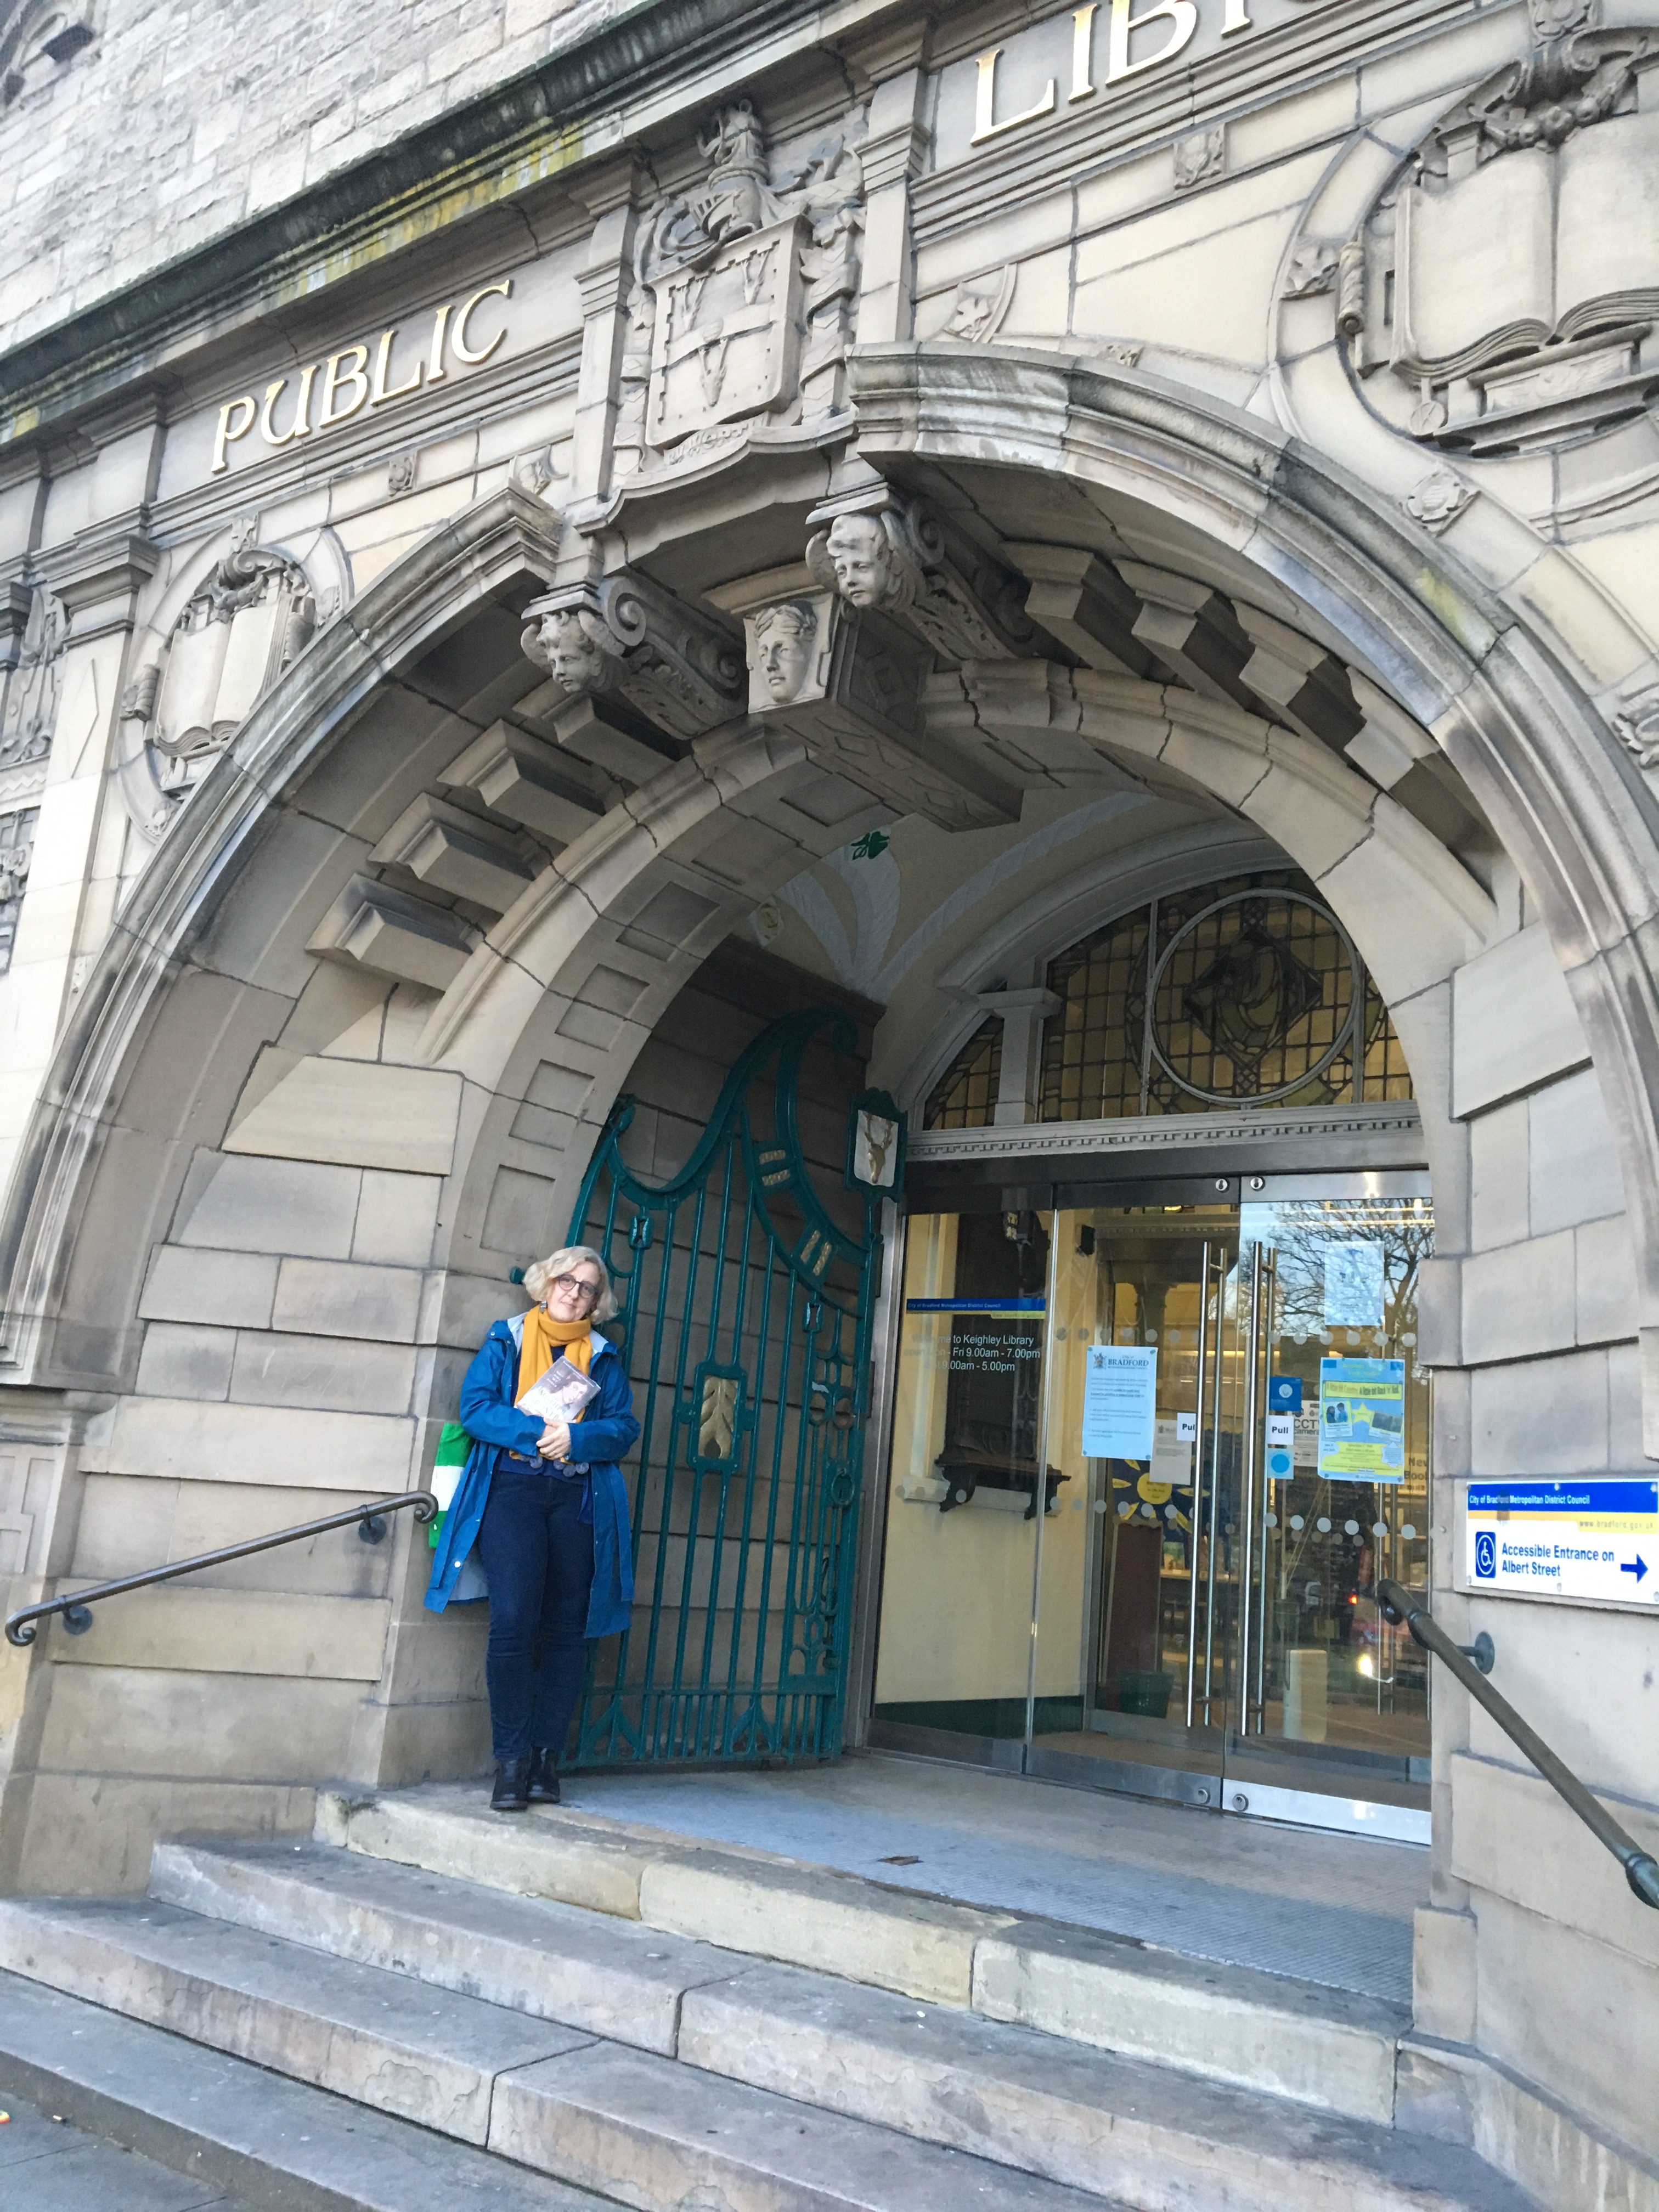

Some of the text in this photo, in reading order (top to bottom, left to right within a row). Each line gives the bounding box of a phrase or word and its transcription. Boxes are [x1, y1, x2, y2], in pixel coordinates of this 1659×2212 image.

[211, 279, 512, 473] PUBLIC
[953, 1334, 962, 1344] to
[963, 1334, 1001, 1346] Keighley
[1003, 1335, 1034, 1347] Library
[952, 1347, 964, 1357] Fri
[966, 1347, 999, 1358] 9.00am
[1007, 1348, 1041, 1361] 7.00pm
[942, 1361, 974, 1370] 9.00am
[981, 1361, 1015, 1373] 5.00pm
[1108, 1358, 1149, 1367] BRADFORD
[1272, 1426, 1289, 1434] Pull
[1294, 1419, 1319, 1429] CCT
[1469, 1495, 1590, 1505] City of Bradford Metropolitan District Council
[1502, 1542, 1615, 1561] Accessible Entrance on
[1502, 1560, 1561, 1577] Albert Street
